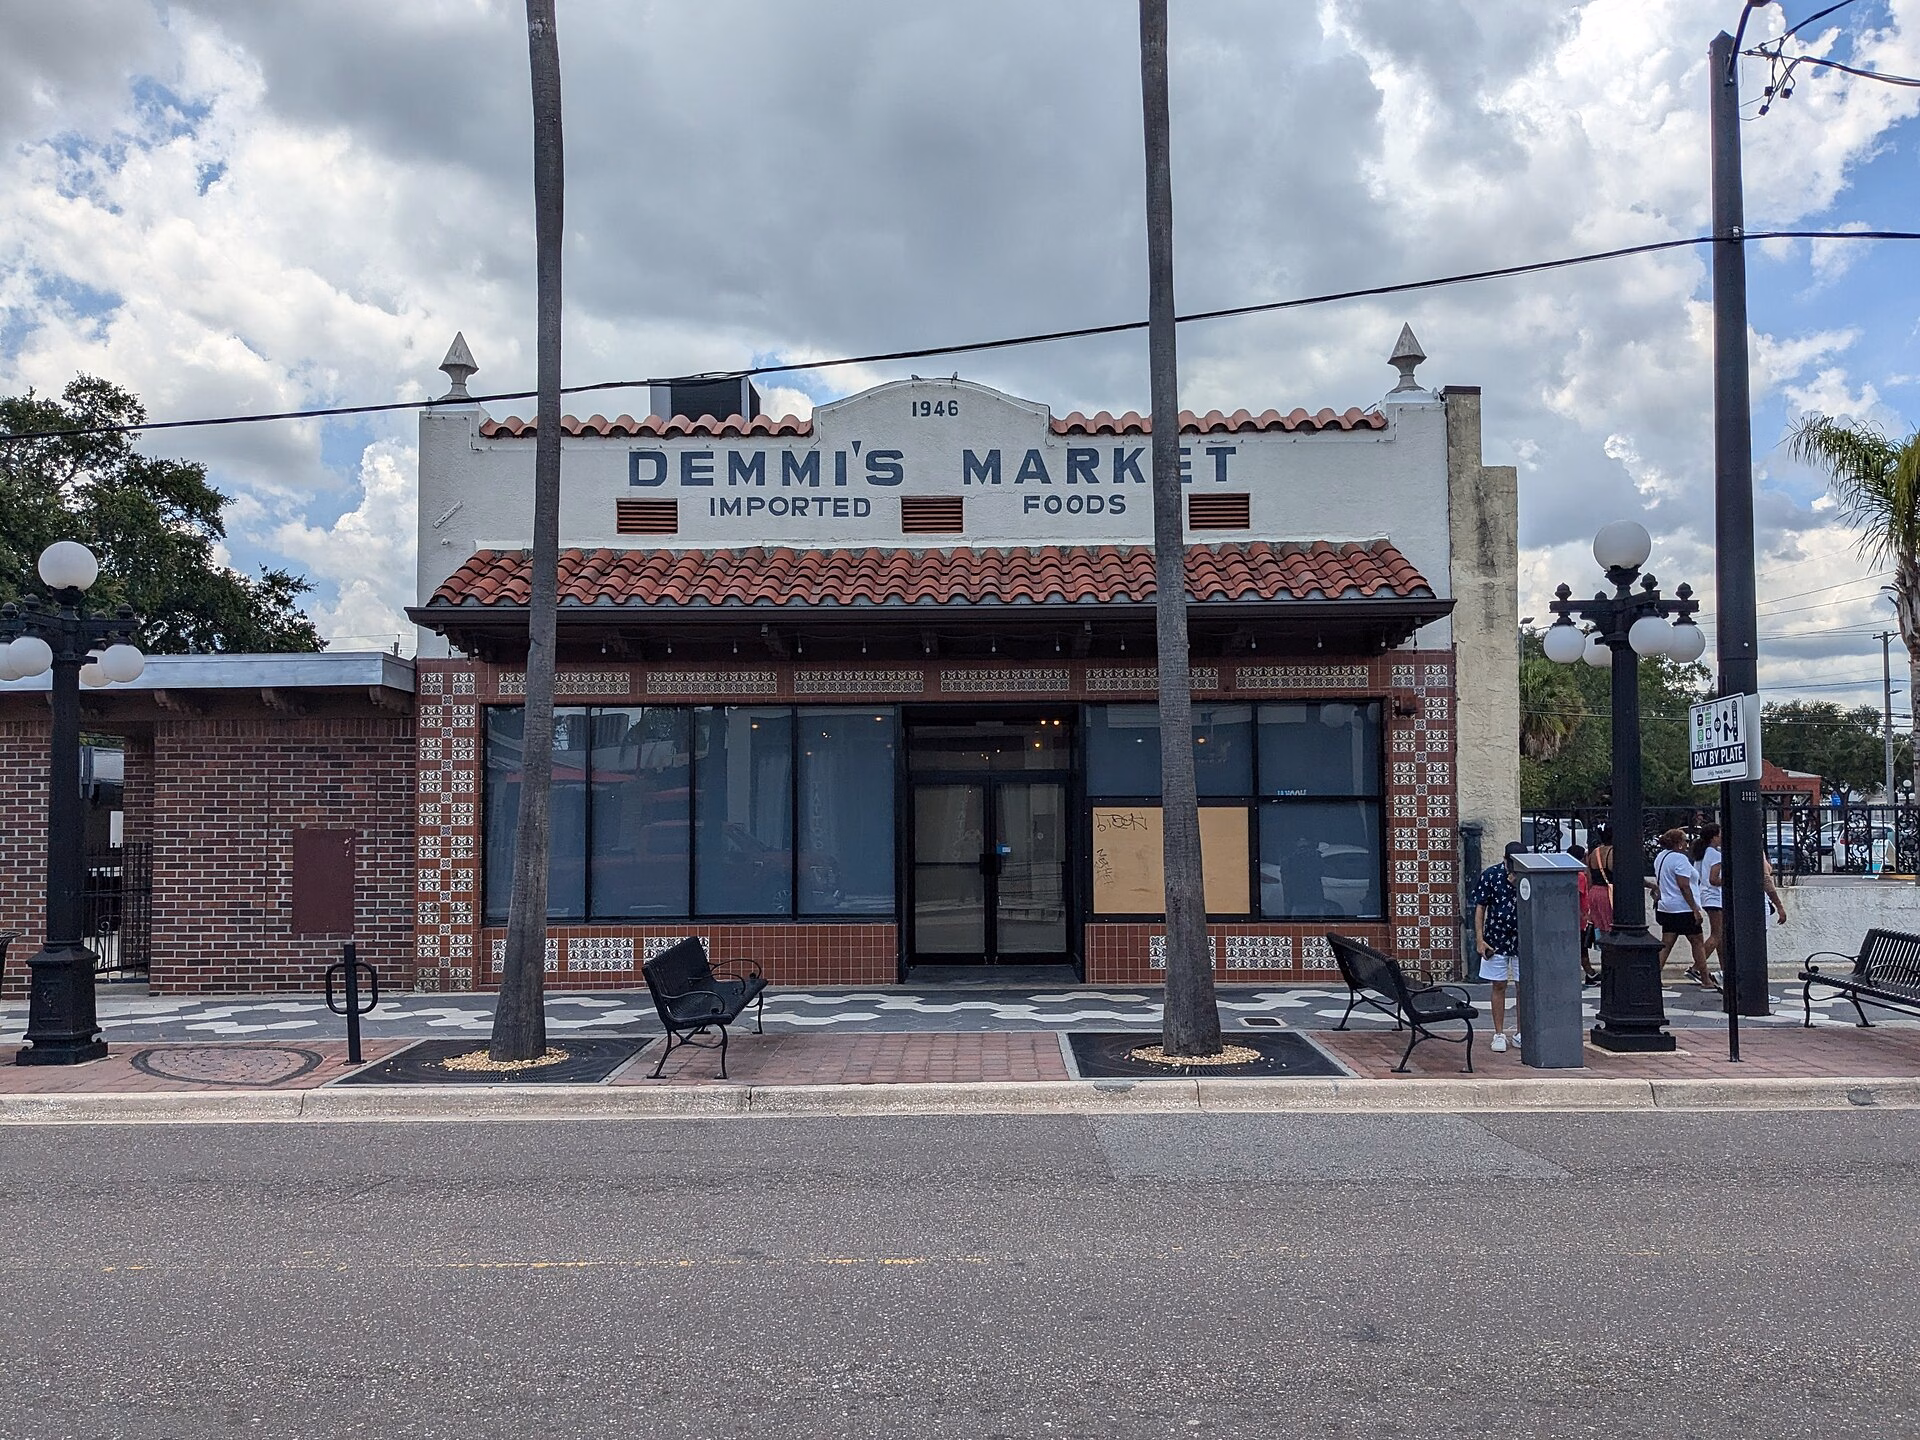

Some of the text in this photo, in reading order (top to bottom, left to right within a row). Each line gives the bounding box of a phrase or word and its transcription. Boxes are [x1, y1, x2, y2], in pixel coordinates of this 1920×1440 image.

[911, 400, 959, 417] 1946
[628, 440, 905, 487] DEMMI'S
[709, 495, 1127, 518] IMPORTED FOODS
[1694, 745, 1743, 767] PAY BY PLATE
